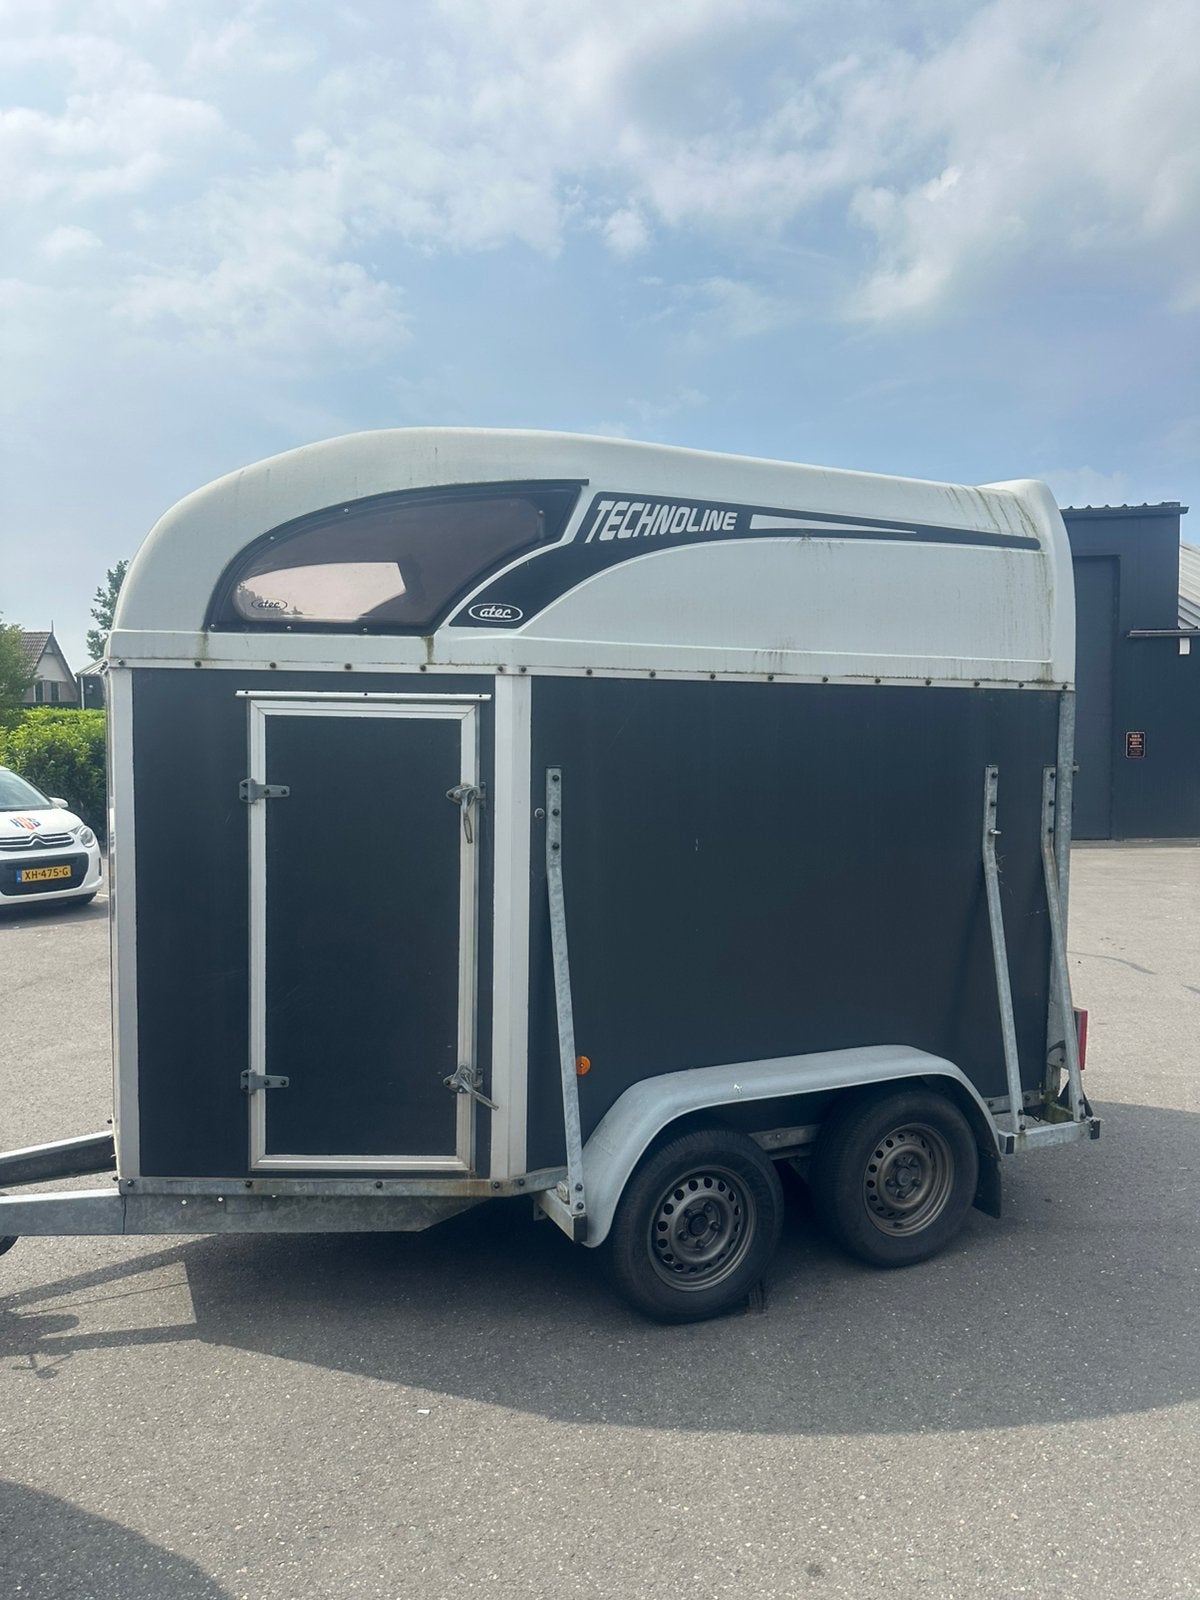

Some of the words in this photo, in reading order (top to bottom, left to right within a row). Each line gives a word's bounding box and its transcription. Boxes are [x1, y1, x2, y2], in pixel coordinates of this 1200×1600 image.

[585, 500, 738, 543] TECHNOLINE
[257, 599, 281, 608] atec
[479, 605, 512, 618] atec
[25, 866, 69, 880] XH-475-G
